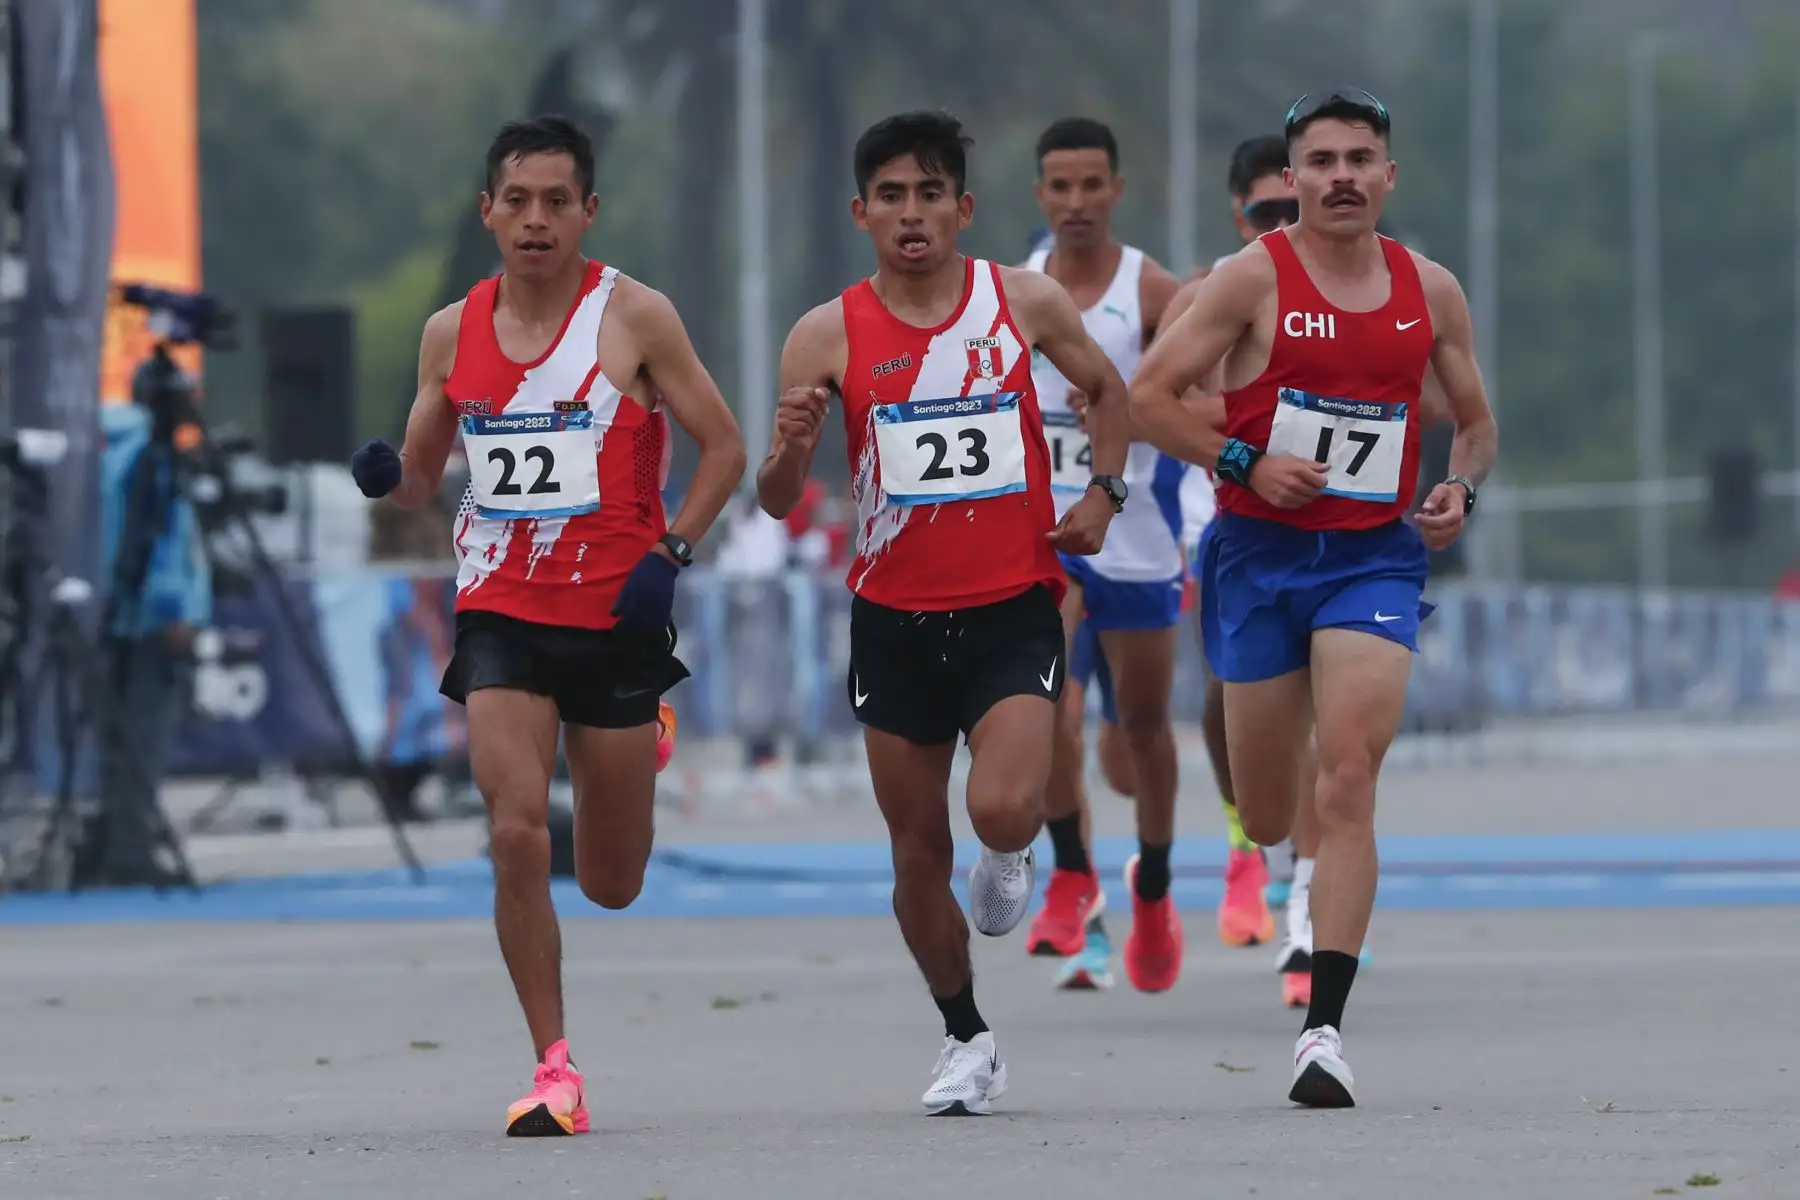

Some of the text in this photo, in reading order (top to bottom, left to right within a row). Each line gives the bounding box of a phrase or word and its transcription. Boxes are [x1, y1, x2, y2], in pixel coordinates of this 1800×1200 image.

[1284, 311, 1335, 338] CHI
[872, 352, 912, 380] PERÚ
[487, 445, 561, 495] 22
[915, 427, 990, 482] 23
[1315, 426, 1381, 477] 17
